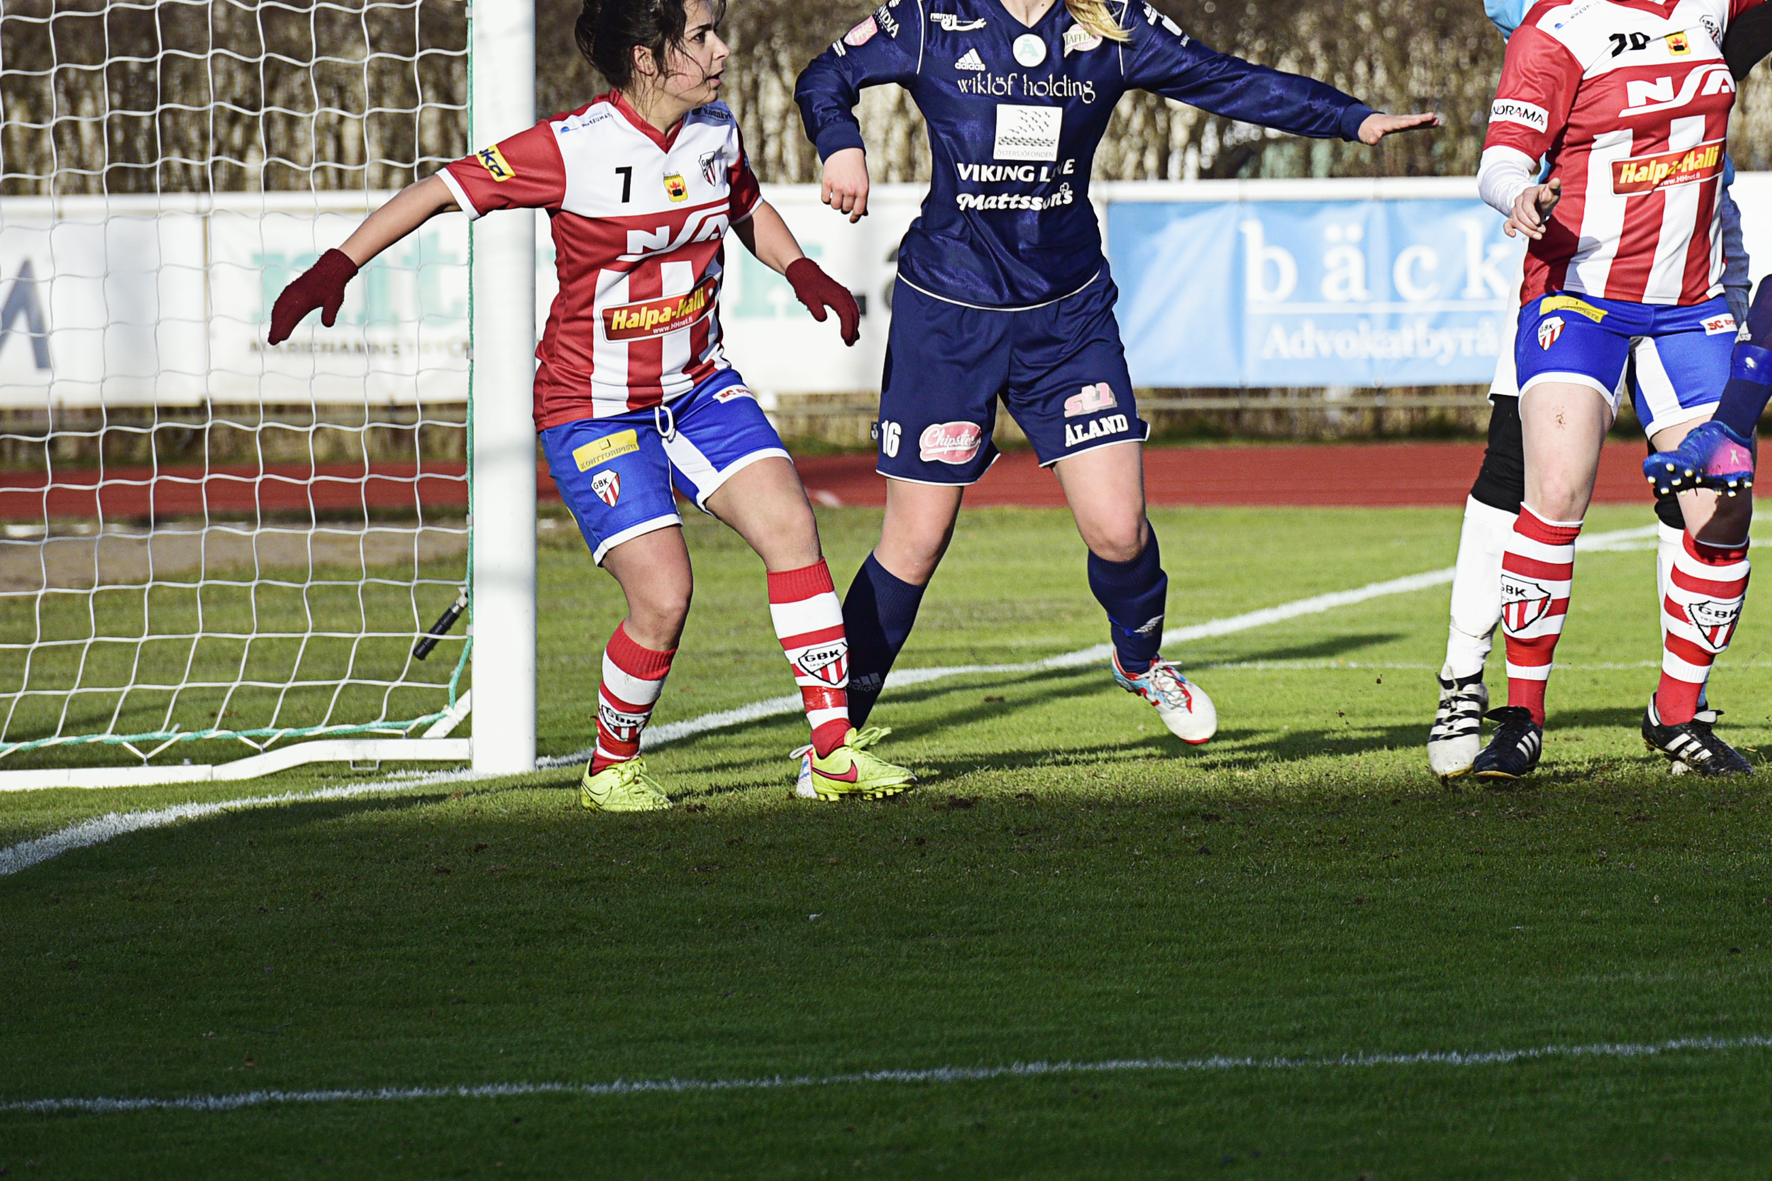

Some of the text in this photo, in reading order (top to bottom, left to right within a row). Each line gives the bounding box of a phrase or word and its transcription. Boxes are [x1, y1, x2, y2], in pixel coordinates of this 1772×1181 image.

[957, 72, 1096, 105] wiklöf holding
[956, 162, 1036, 182] VIKING
[1619, 145, 1720, 185] Halpa-Halli
[614, 165, 633, 204] 7
[955, 189, 1075, 212] Mattsson's
[611, 286, 706, 331] Halpa-Halli
[880, 419, 902, 459] 16
[1064, 413, 1129, 447] ÅLAND
[592, 476, 611, 491] GBK
[804, 648, 841, 663] GBK
